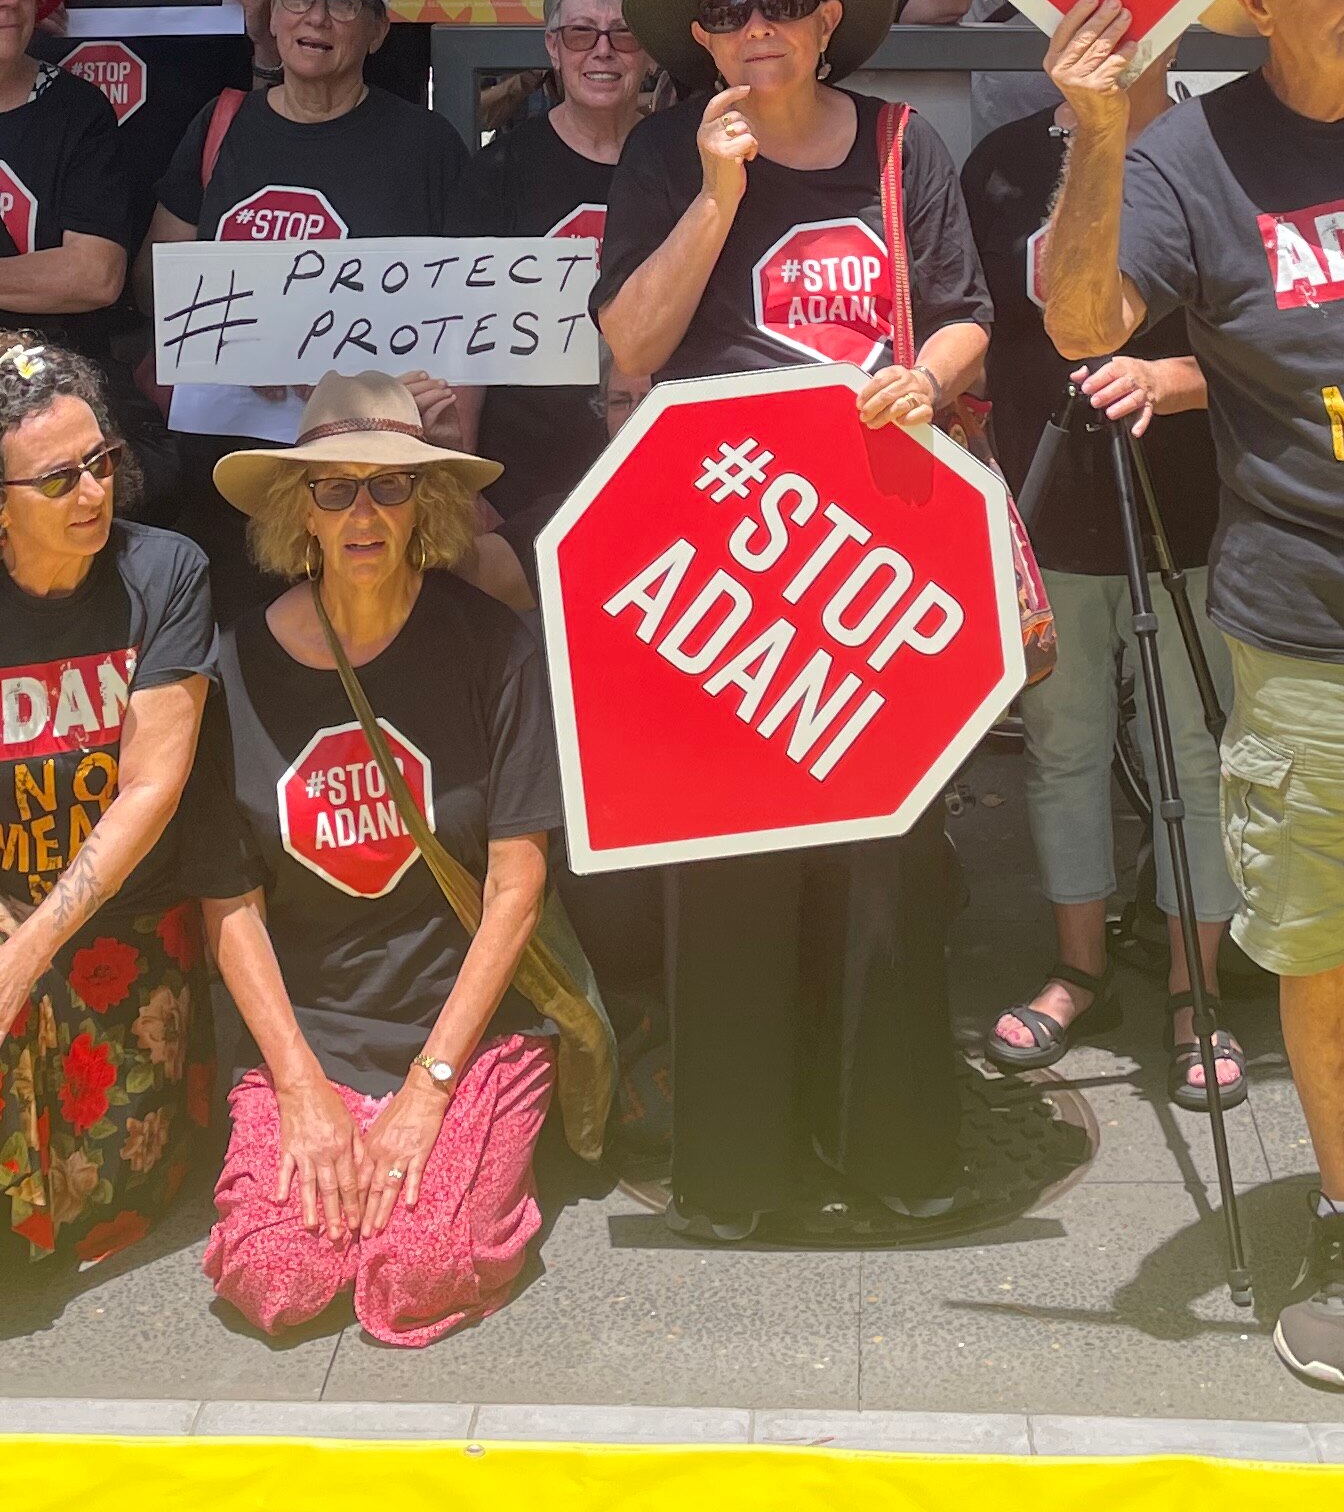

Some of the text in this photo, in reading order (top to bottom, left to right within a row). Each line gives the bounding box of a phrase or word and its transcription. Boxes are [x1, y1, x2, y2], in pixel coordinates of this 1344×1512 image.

[236, 207, 325, 239] #STOP
[284, 249, 593, 294] PROTECT
[781, 257, 882, 291] #STOP
[298, 311, 589, 360] PROTEST
[788, 296, 878, 329] ADANI
[694, 437, 965, 674] #STOP
[603, 538, 886, 781] ADANI
[14, 752, 119, 821] NO
